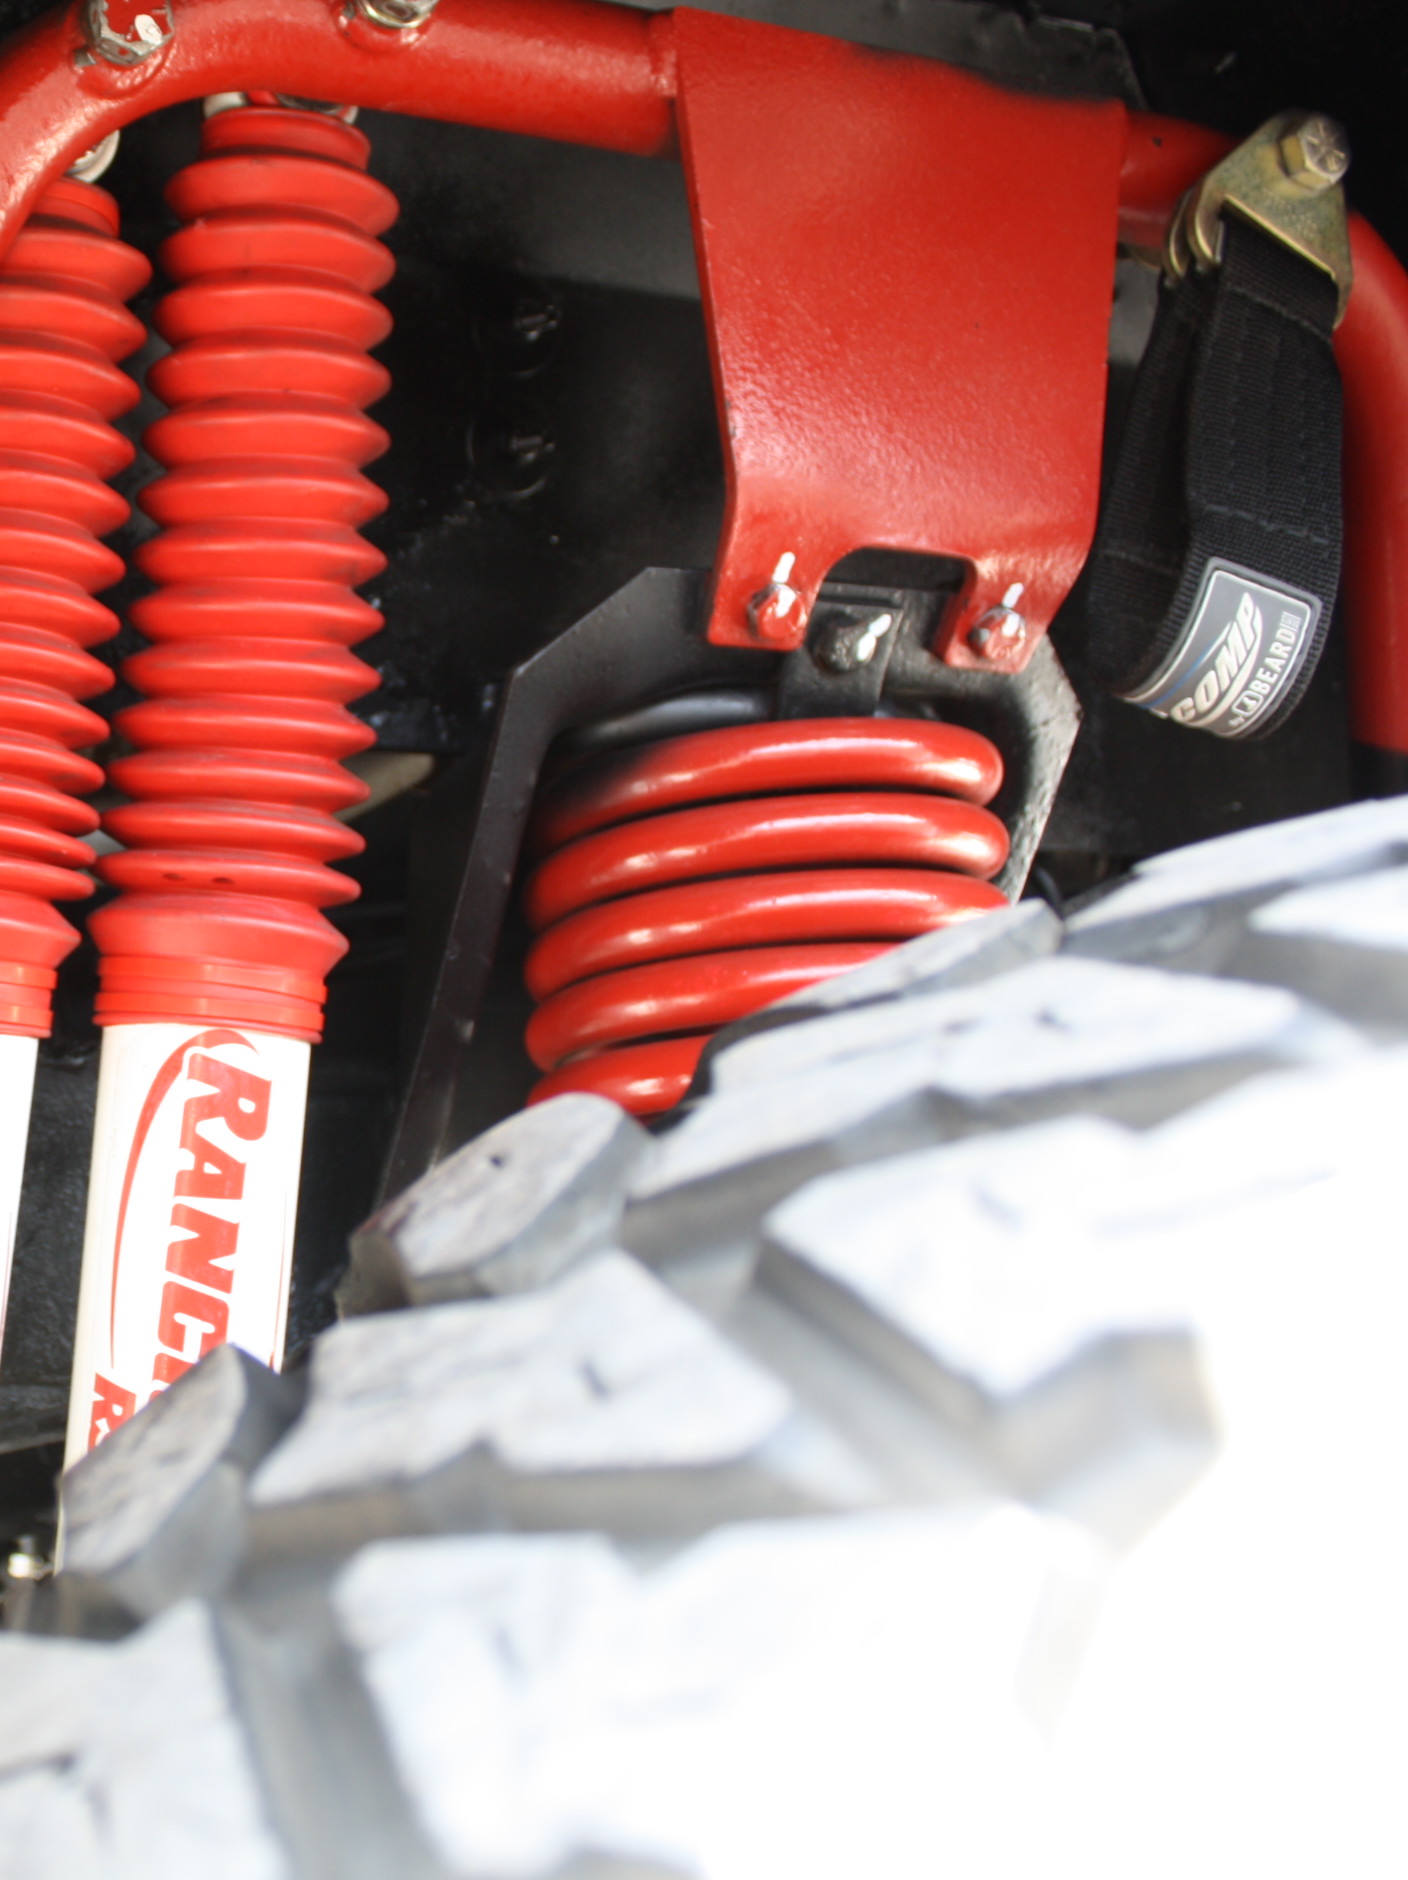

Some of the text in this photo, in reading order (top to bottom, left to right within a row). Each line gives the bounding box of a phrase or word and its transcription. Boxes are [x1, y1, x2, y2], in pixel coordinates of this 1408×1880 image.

[1171, 592, 1256, 721] COMP
[1248, 627, 1297, 695] BEARD
[149, 1053, 272, 1400] RANC
